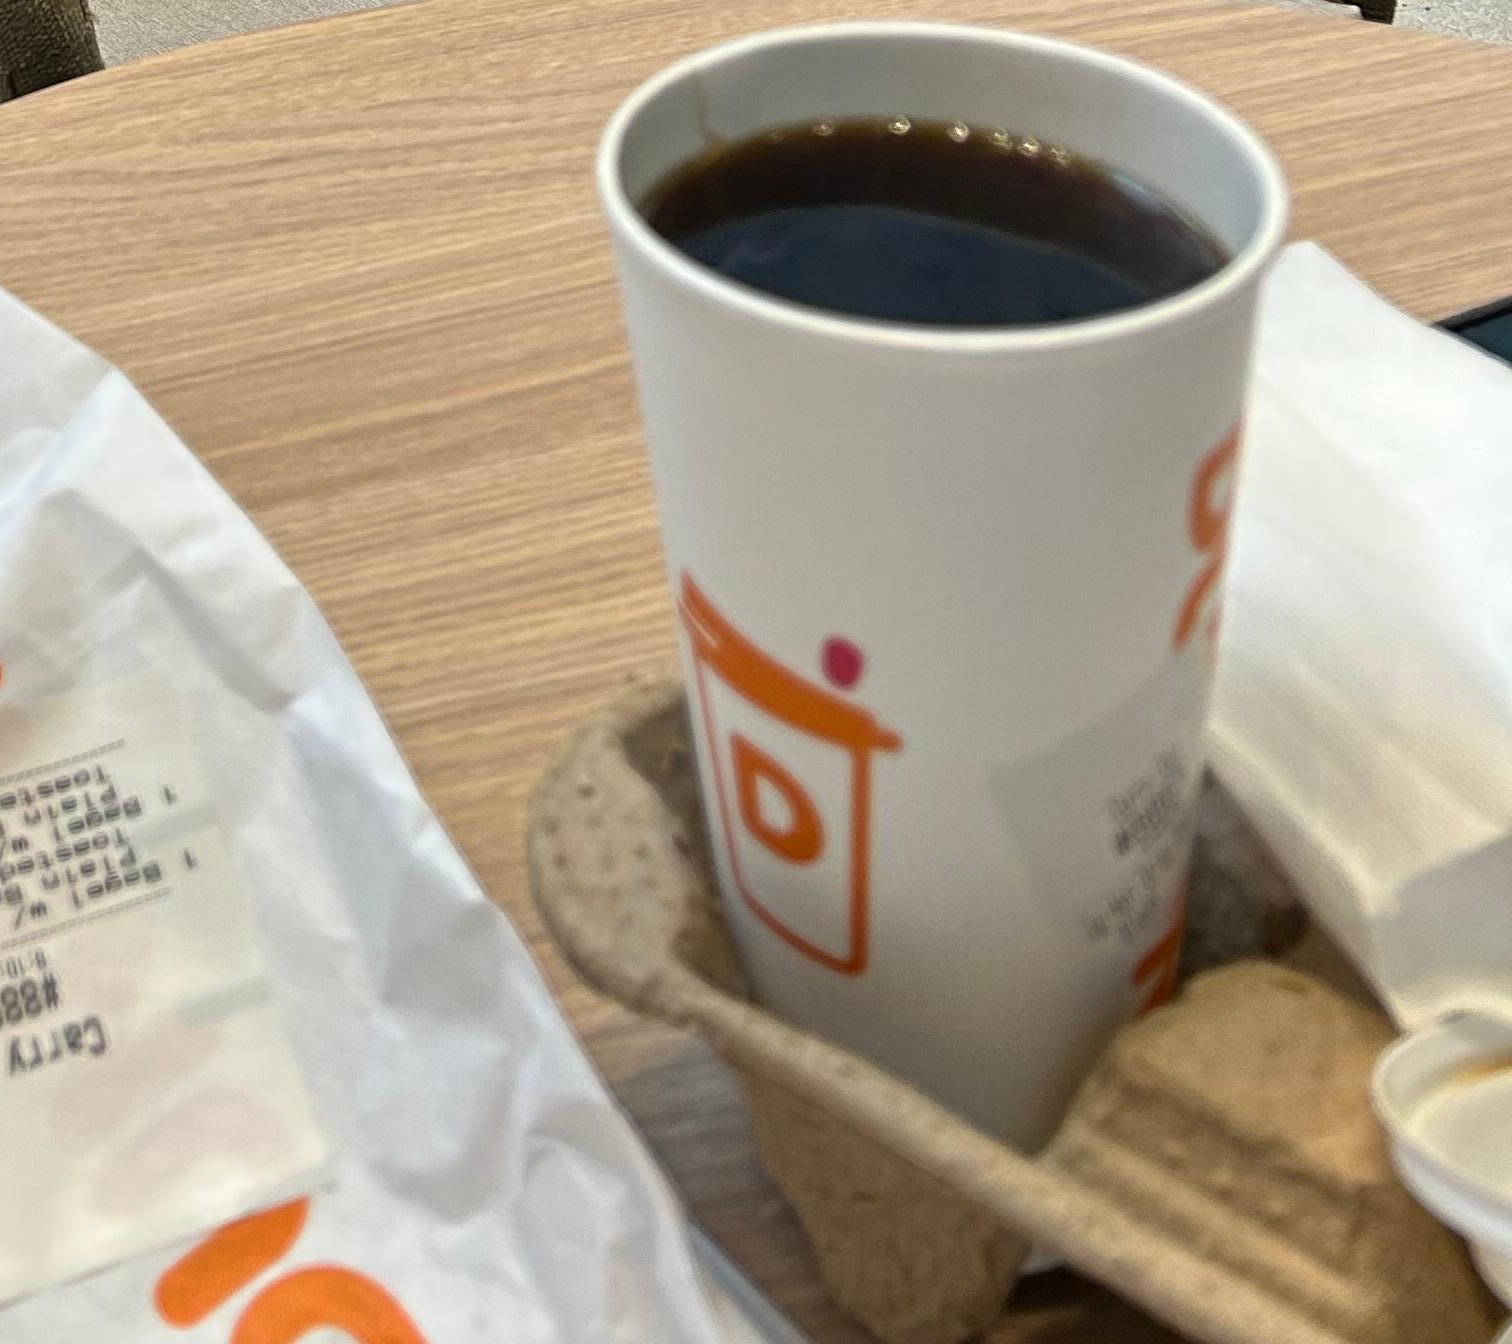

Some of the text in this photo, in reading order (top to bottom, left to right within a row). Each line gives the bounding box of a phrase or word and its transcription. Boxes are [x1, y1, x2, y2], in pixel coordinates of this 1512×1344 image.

[24, 783, 118, 826] Plain
[53, 795, 142, 844] Bagel
[40, 845, 138, 890] Plain
[71, 861, 163, 911] Bagel
[7, 1014, 108, 1077] Carry
